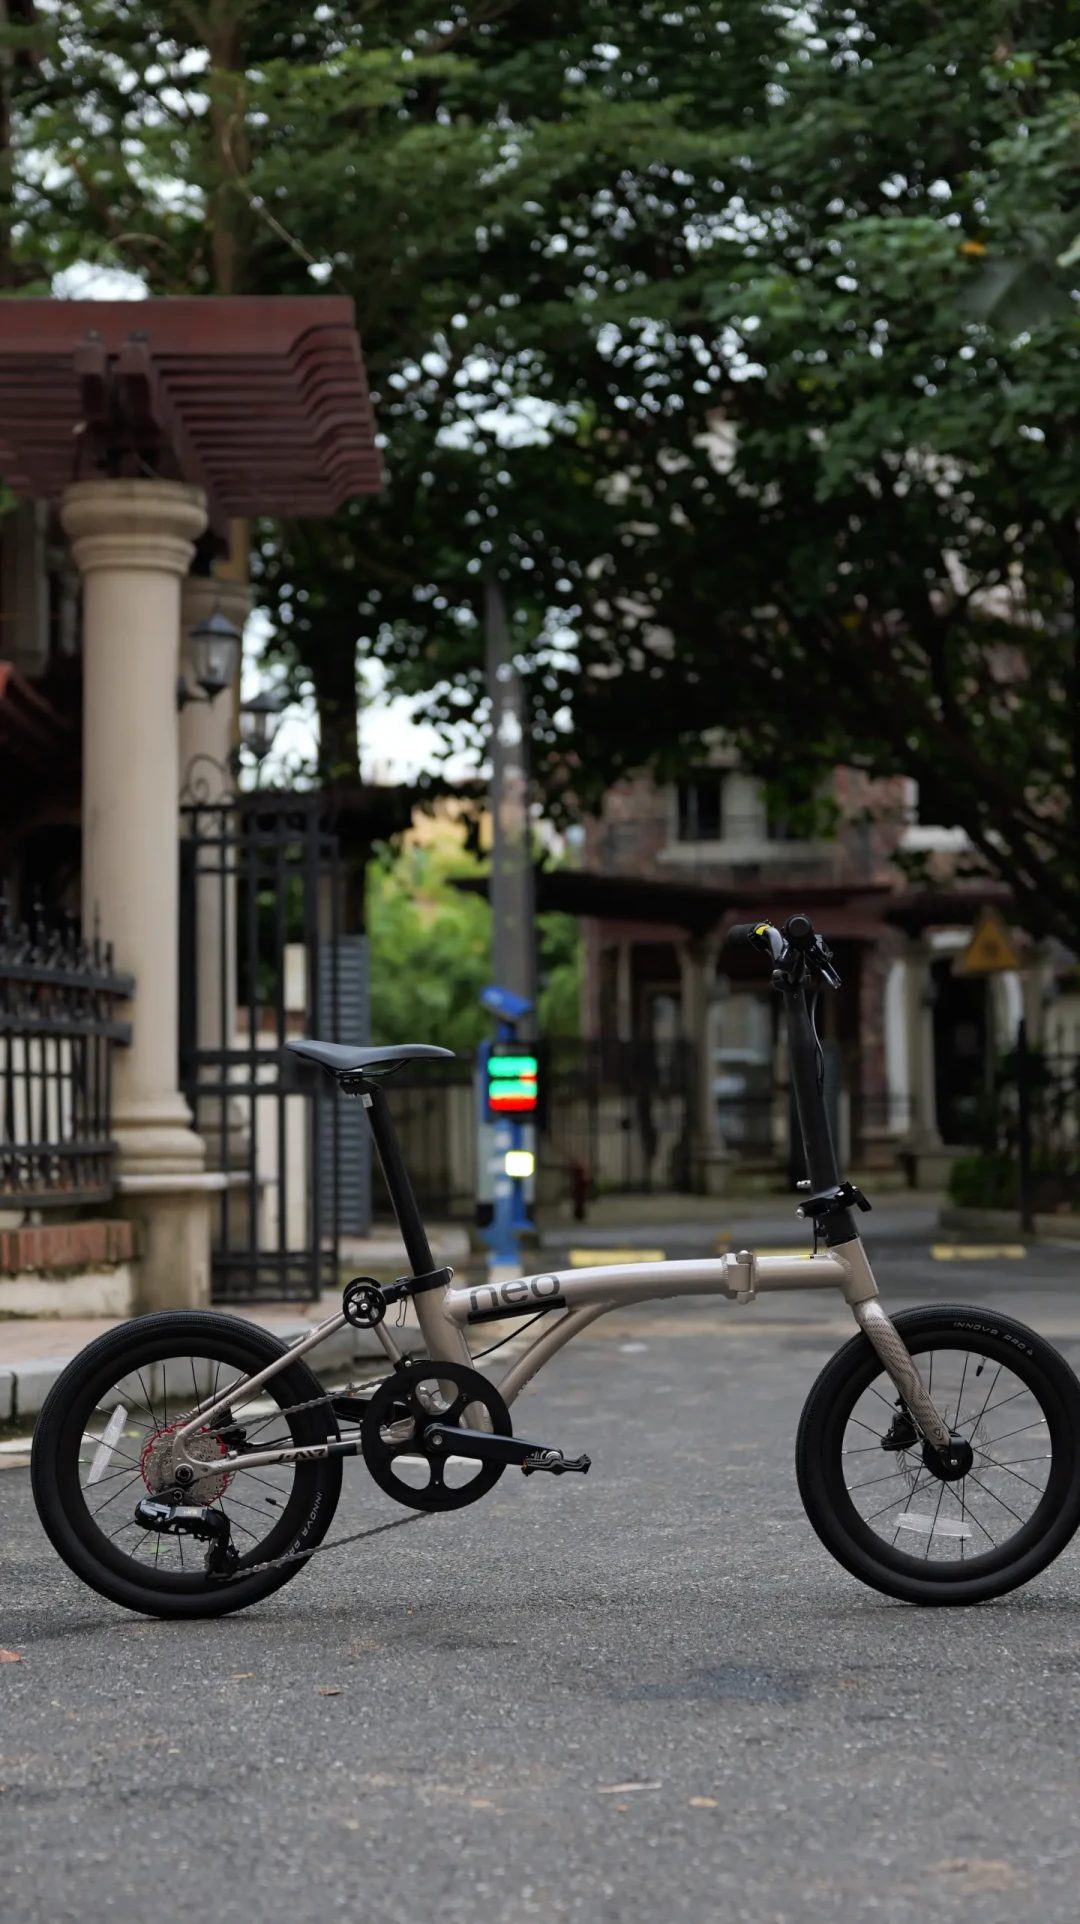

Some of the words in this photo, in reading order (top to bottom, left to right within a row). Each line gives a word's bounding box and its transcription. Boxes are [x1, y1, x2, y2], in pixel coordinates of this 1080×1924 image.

[469, 1275, 560, 1311] neo
[953, 1321, 999, 1335] INNOVA
[1003, 1334, 1026, 1350] PRO
[301, 1491, 322, 1537] INNOVA
